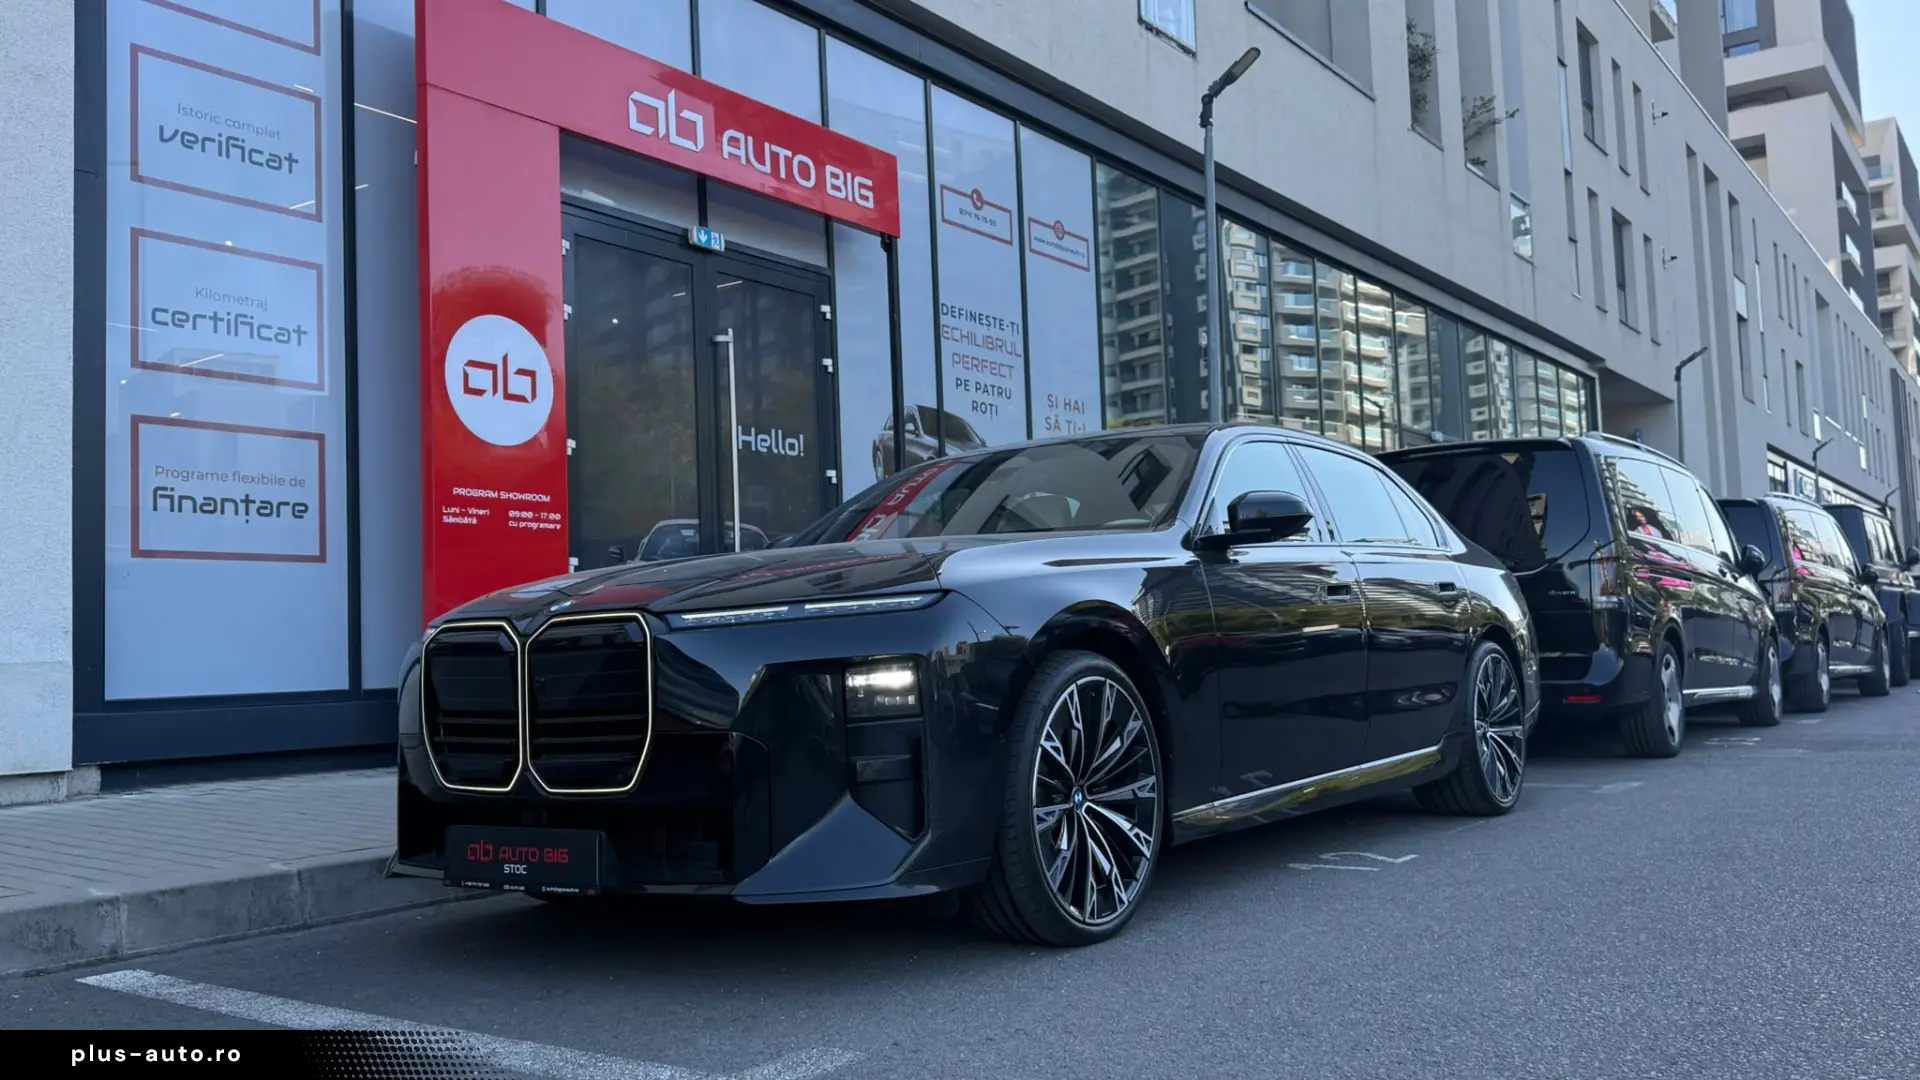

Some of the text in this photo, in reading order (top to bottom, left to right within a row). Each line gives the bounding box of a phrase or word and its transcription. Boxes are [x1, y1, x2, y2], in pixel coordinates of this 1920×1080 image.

[177, 102, 282, 141] Istoric complet
[158, 124, 299, 174] verificat
[722, 129, 817, 189] AUTO
[825, 164, 875, 210] BIG
[195, 286, 268, 312] Kilometraj
[151, 307, 308, 346] certificat
[941, 302, 1020, 337] DEFINEȘTE-ȚI
[941, 323, 1022, 358] ECHILIBRUL
[952, 352, 1015, 379] PERFECT
[955, 377, 1012, 400] PE PATRU
[971, 400, 998, 420] ROȚI
[1063, 397, 1085, 415] HAI
[738, 425, 804, 457] Hello!
[154, 465, 306, 488] Programe flexibile de
[152, 486, 309, 524] finanțare
[453, 487, 551, 502] PROGRAM SHOWROOM
[442, 505, 459, 513] Luni
[467, 508, 490, 516] Vineri
[519, 521, 561, 530] programare
[499, 846, 539, 862] AUTO
[543, 848, 569, 863] BIG
[503, 863, 527, 874] STOC
